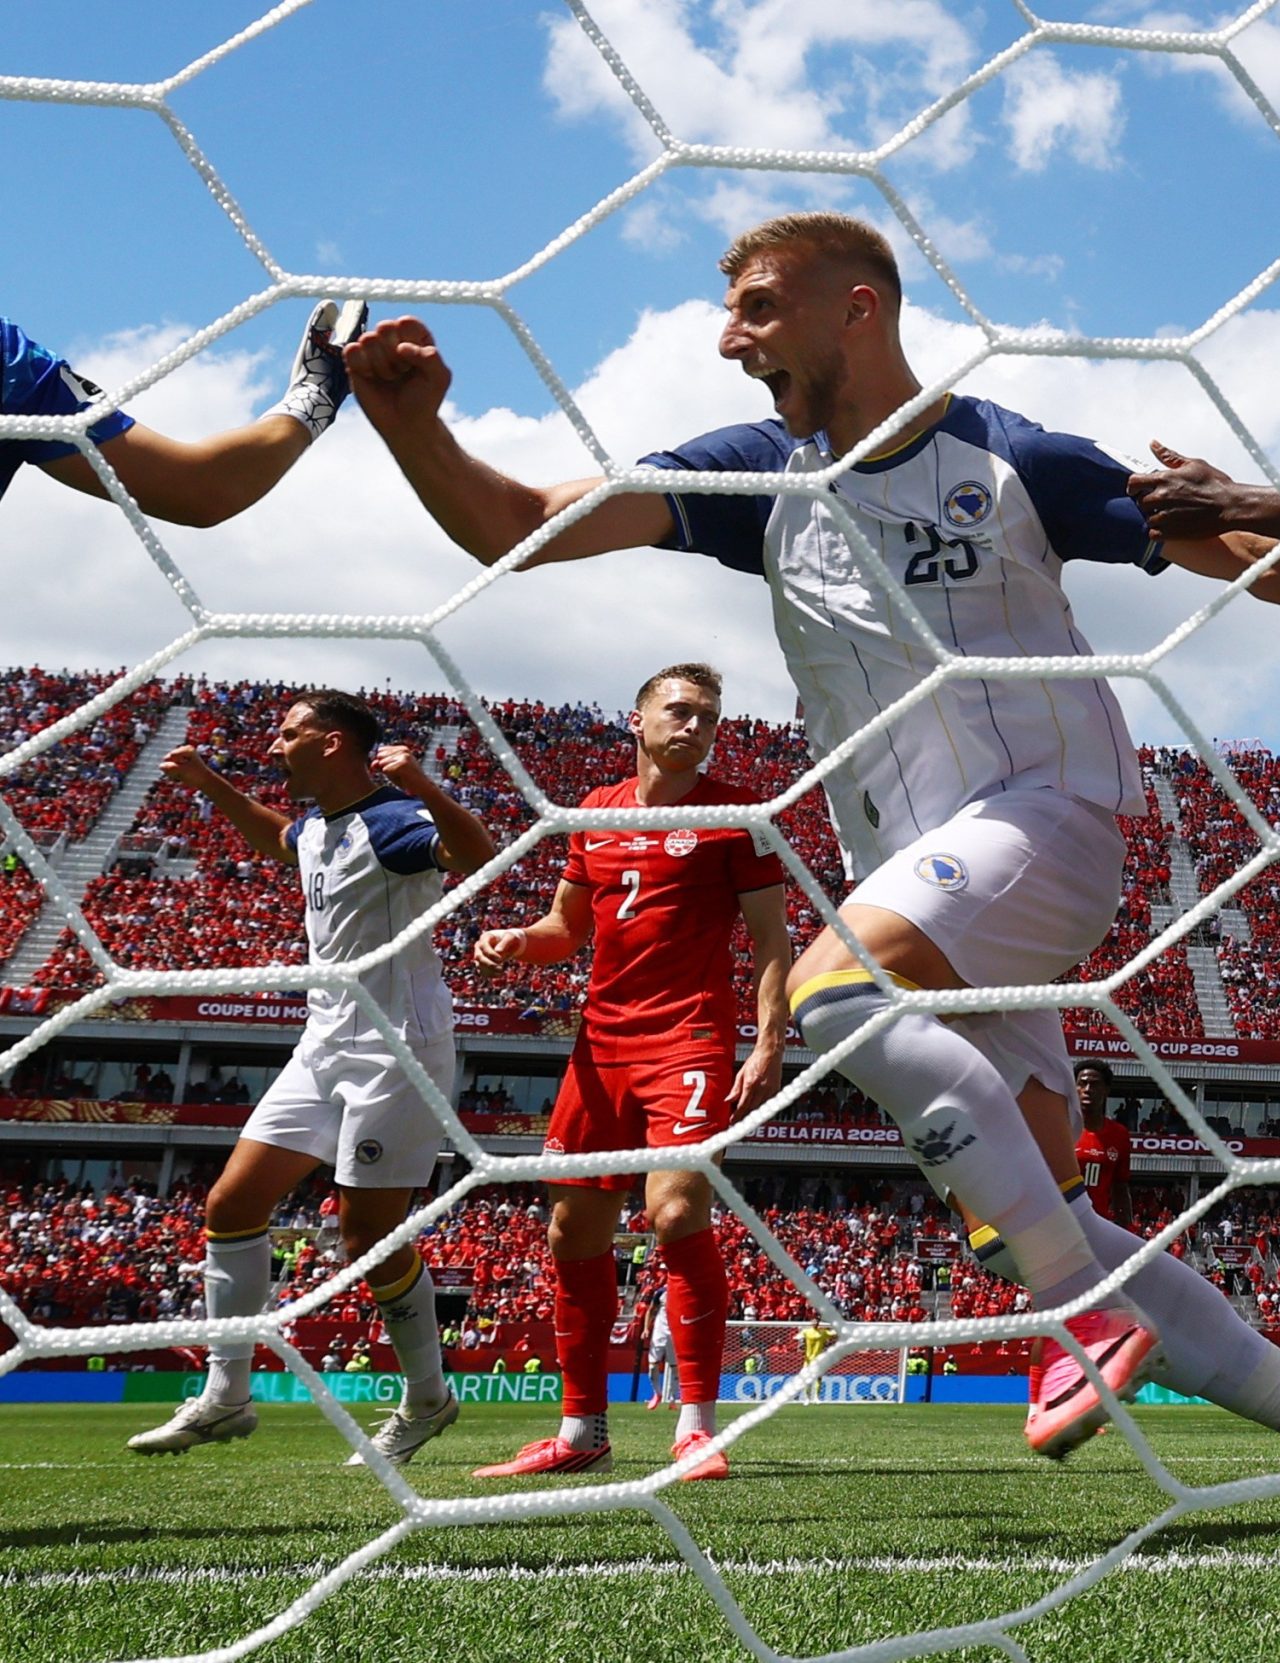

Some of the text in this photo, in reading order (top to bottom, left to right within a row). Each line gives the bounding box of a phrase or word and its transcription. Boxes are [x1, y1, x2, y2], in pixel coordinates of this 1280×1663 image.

[308, 871, 325, 912] 18
[616, 870, 641, 920] 2
[197, 1002, 254, 1017] COUPE
[256, 1004, 281, 1018] DU
[452, 1013, 490, 1026] 026
[1075, 1039, 1240, 1057] FIFA WOD CUP 2026
[681, 1070, 708, 1119] 2
[767, 1126, 787, 1138] DE
[789, 1127, 809, 1139] LA
[811, 1128, 844, 1140] FIFA
[847, 1129, 900, 1142] 2026
[1130, 1137, 1244, 1152] TORONO
[1084, 1162, 1101, 1187] 10
[445, 1374, 559, 1401] ARTNER
